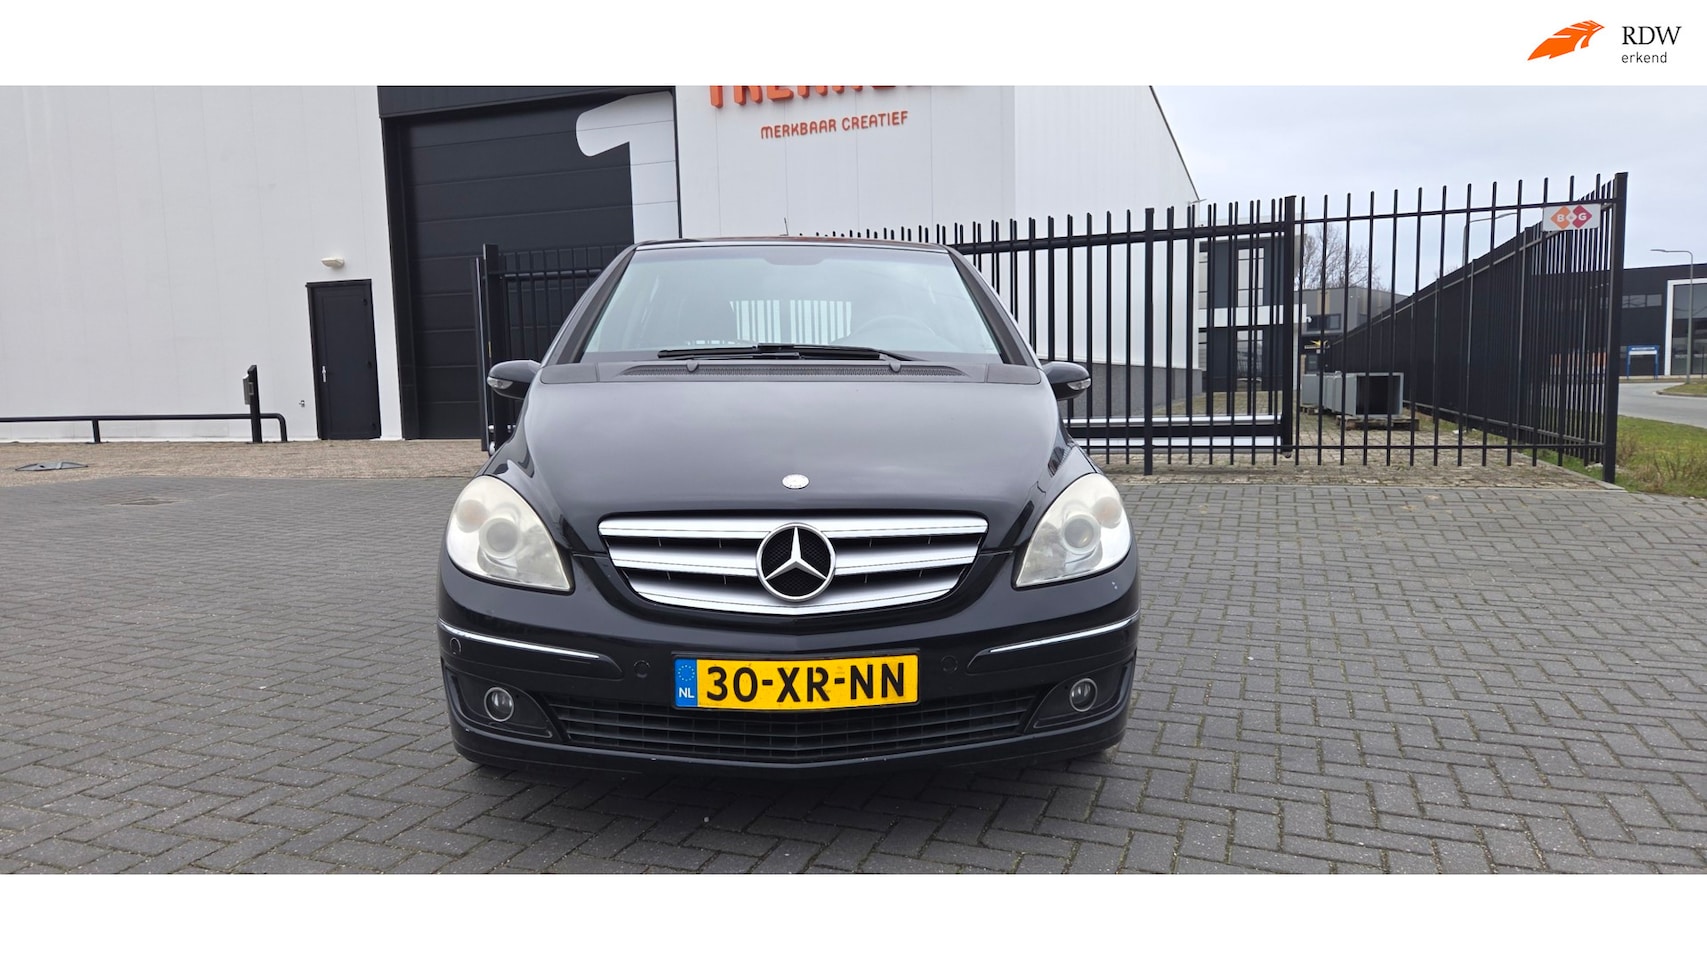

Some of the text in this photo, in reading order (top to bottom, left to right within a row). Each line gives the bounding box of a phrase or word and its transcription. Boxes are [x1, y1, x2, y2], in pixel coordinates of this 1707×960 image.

[760, 111, 908, 139] MERKBAAR CREATIEF
[678, 687, 694, 698] NL
[706, 662, 905, 703] 30-XR-NN
